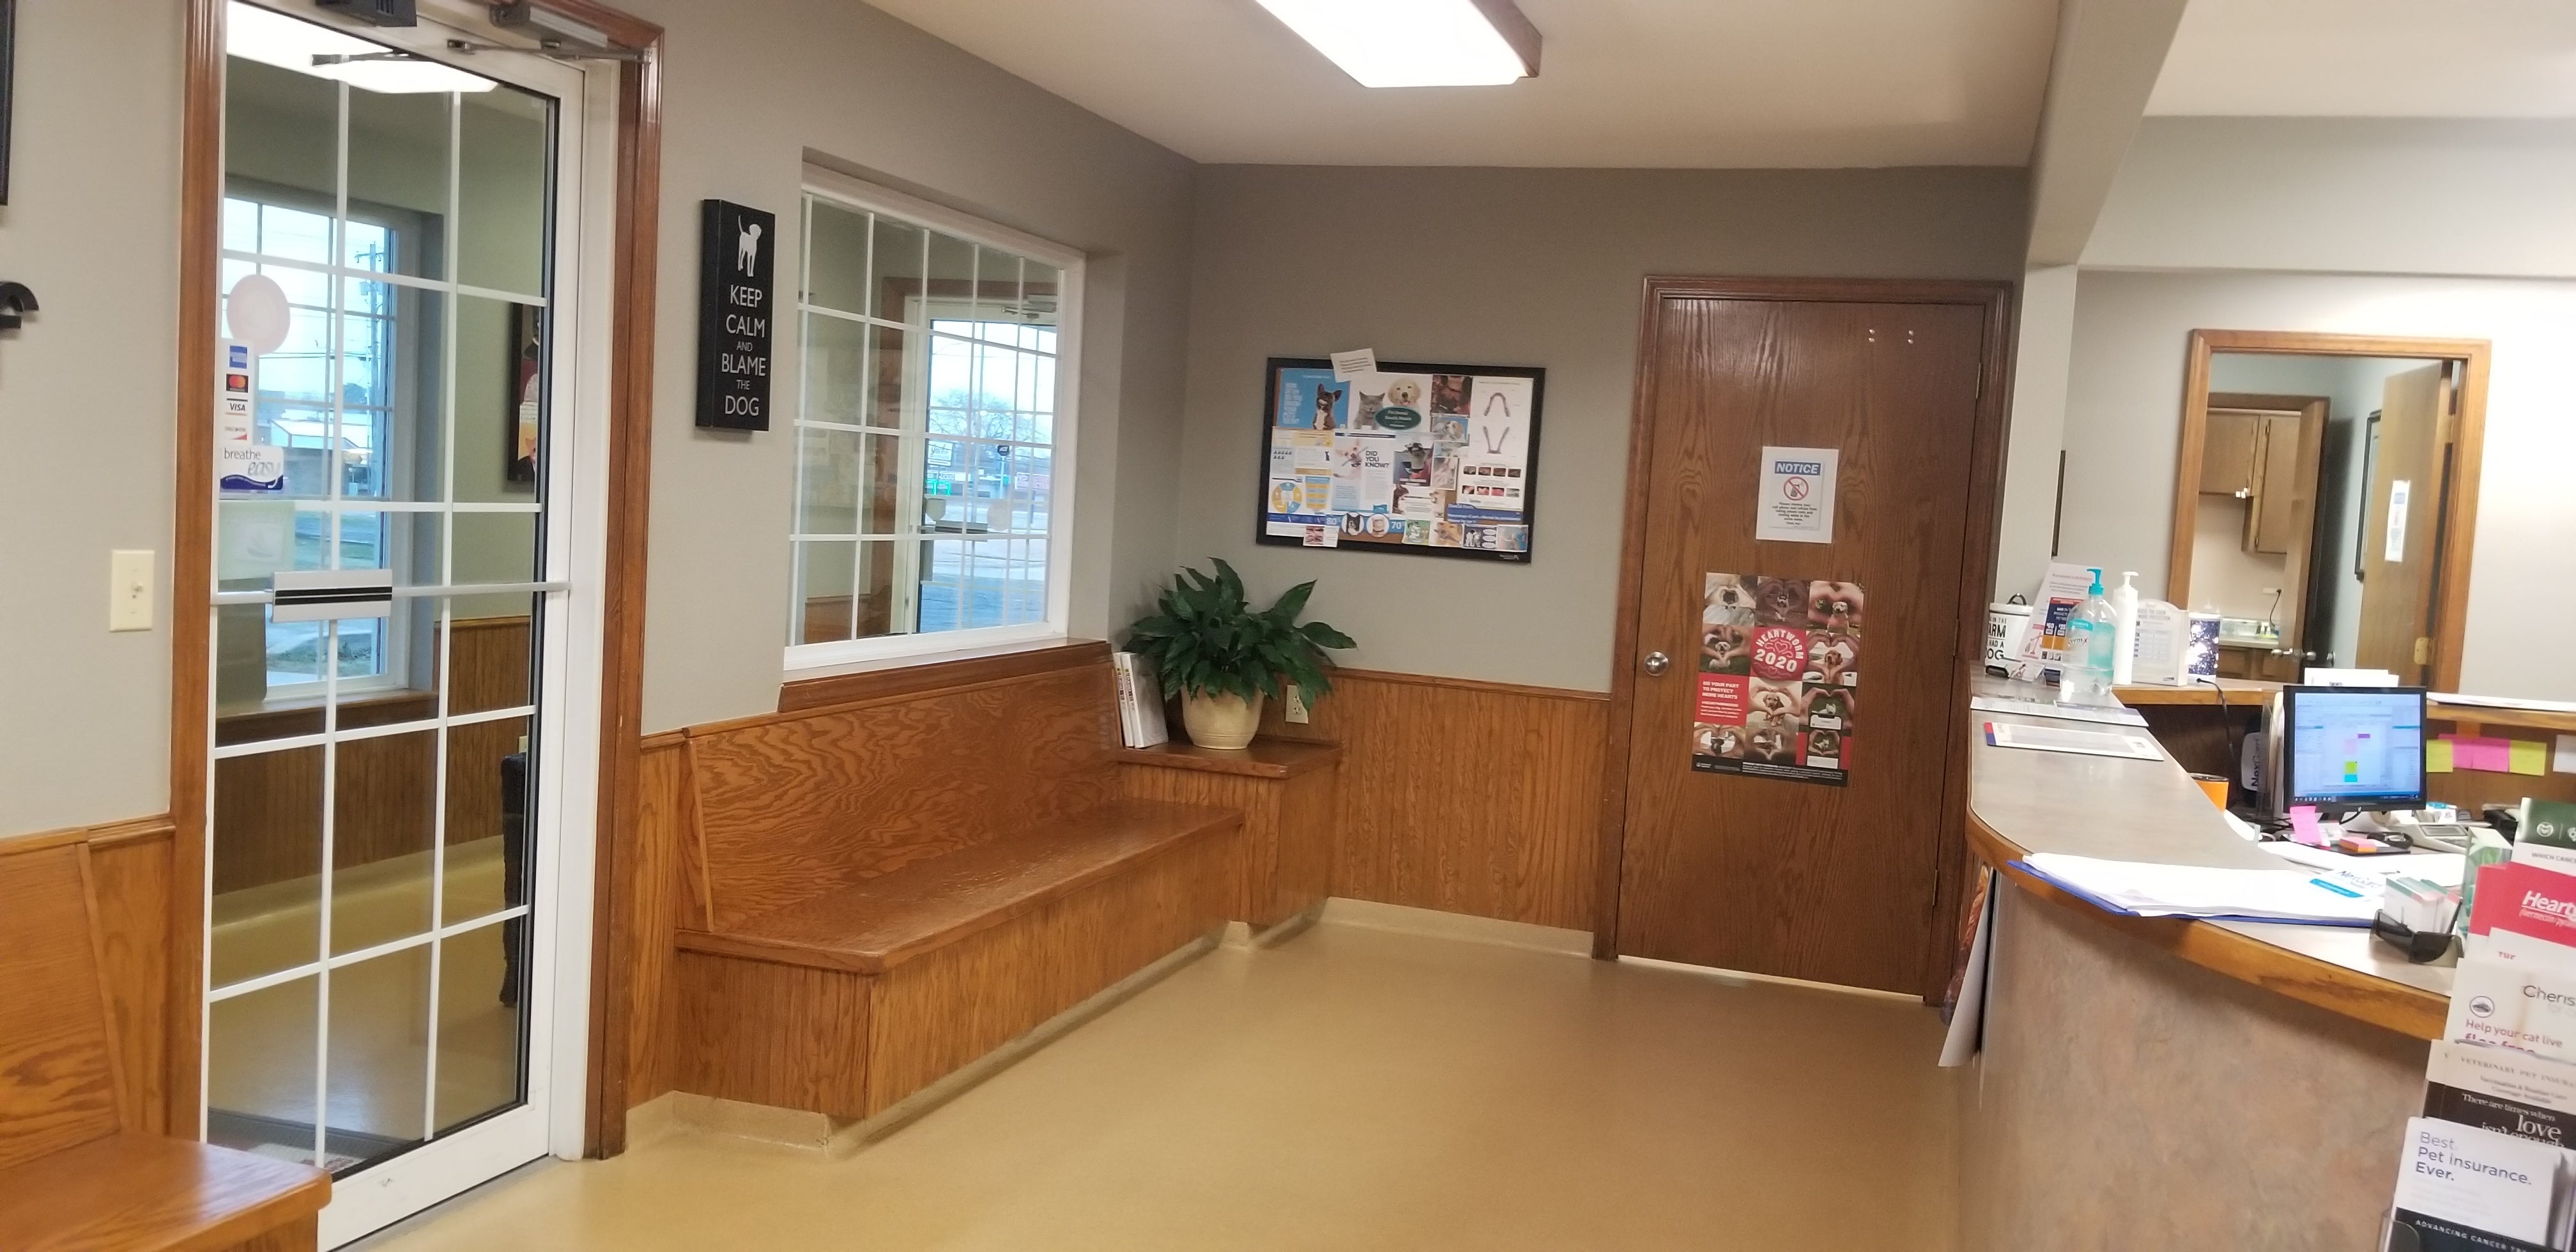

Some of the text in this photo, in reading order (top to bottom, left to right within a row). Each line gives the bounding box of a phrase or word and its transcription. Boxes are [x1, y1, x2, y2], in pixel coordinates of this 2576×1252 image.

[730, 284, 762, 308] KEEP
[726, 314, 765, 338] CALM
[737, 341, 753, 352] AND
[721, 353, 766, 376] BLAME
[737, 379, 750, 390] THE
[230, 403, 246, 411] VISA
[724, 395, 760, 416] DOG
[224, 448, 261, 461] breathe
[1776, 462, 1819, 474] NOTICE
[1988, 623, 2007, 637] ARM
[1755, 629, 1804, 659] HEARTWORM
[1987, 648, 2004, 660] OG
[1754, 648, 1797, 673] 2020
[2523, 984, 2576, 1007] Cheris
[2466, 1019, 2491, 1034] Help
[2494, 1026, 2520, 1038] your
[2522, 1032, 2540, 1042] cat
[2542, 1035, 2563, 1048] live
[2461, 1057, 2515, 1074] VETERINARY
[2520, 1070, 2537, 1079] PET
[2462, 1093, 2555, 1122] There are times when
[2516, 1114, 2562, 1140] love
[2420, 1131, 2457, 1150] Best.
[2416, 1161, 2454, 1181] Ever.
[2418, 1146, 2532, 1185] Pet insurance.
[2415, 1219, 2468, 1239] ADVANCING
[2471, 1235, 2506, 1250] CANCER
